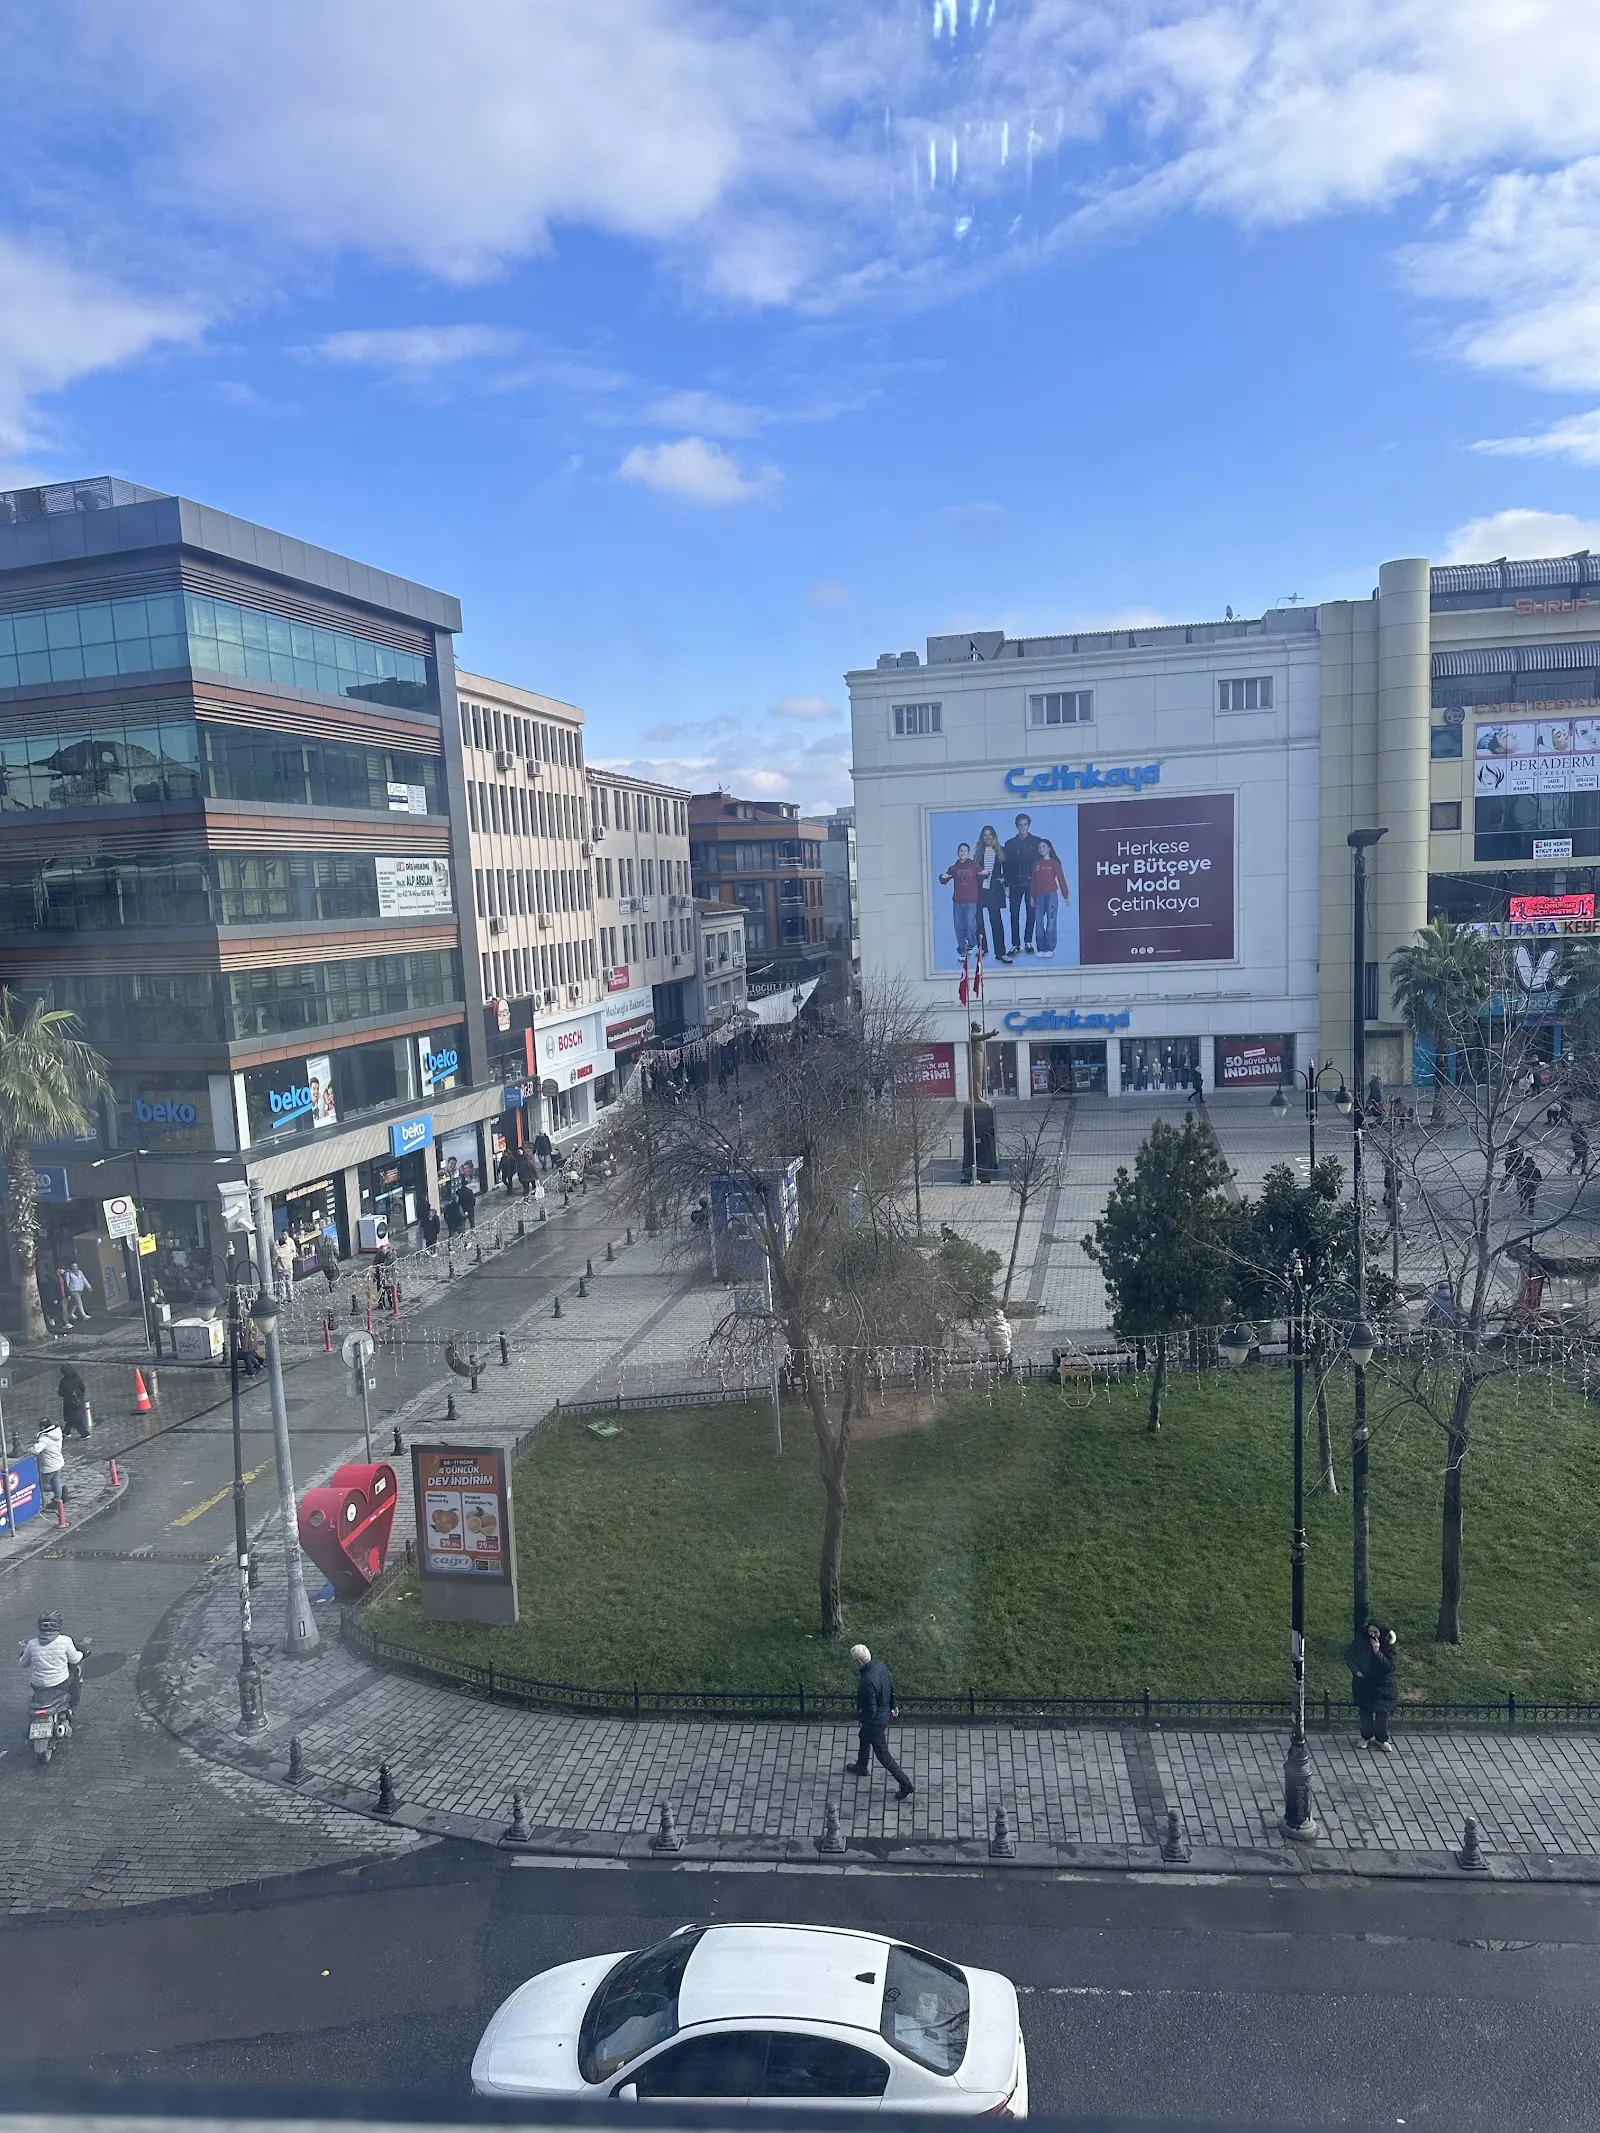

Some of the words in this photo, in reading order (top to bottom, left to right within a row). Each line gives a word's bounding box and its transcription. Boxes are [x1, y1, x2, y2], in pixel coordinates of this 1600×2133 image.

[1510, 756, 1595, 771] PERADERM
[1005, 762, 1160, 798] Çetinkaya
[1117, 840, 1190, 856] Herkese
[1096, 861, 1130, 876] Her
[1133, 858, 1212, 876] Bütçeye
[1127, 877, 1180, 893] Moda
[1107, 896, 1200, 916] Çetinkaya
[1004, 1009, 1130, 1036] Çetinkaya
[557, 1030, 583, 1051] BOSCH
[428, 1049, 458, 1071] beko
[1244, 1056, 1268, 1066] BÜYÜK
[1224, 1063, 1282, 1078] İNDİRİMİ
[269, 1085, 312, 1113] beko
[136, 1098, 196, 1123] beko
[401, 1121, 426, 1141] beko
[446, 1465, 479, 1474] GÜNLÜK
[427, 1476, 450, 1486] DEV
[451, 1474, 493, 1486] İNDİRİM
